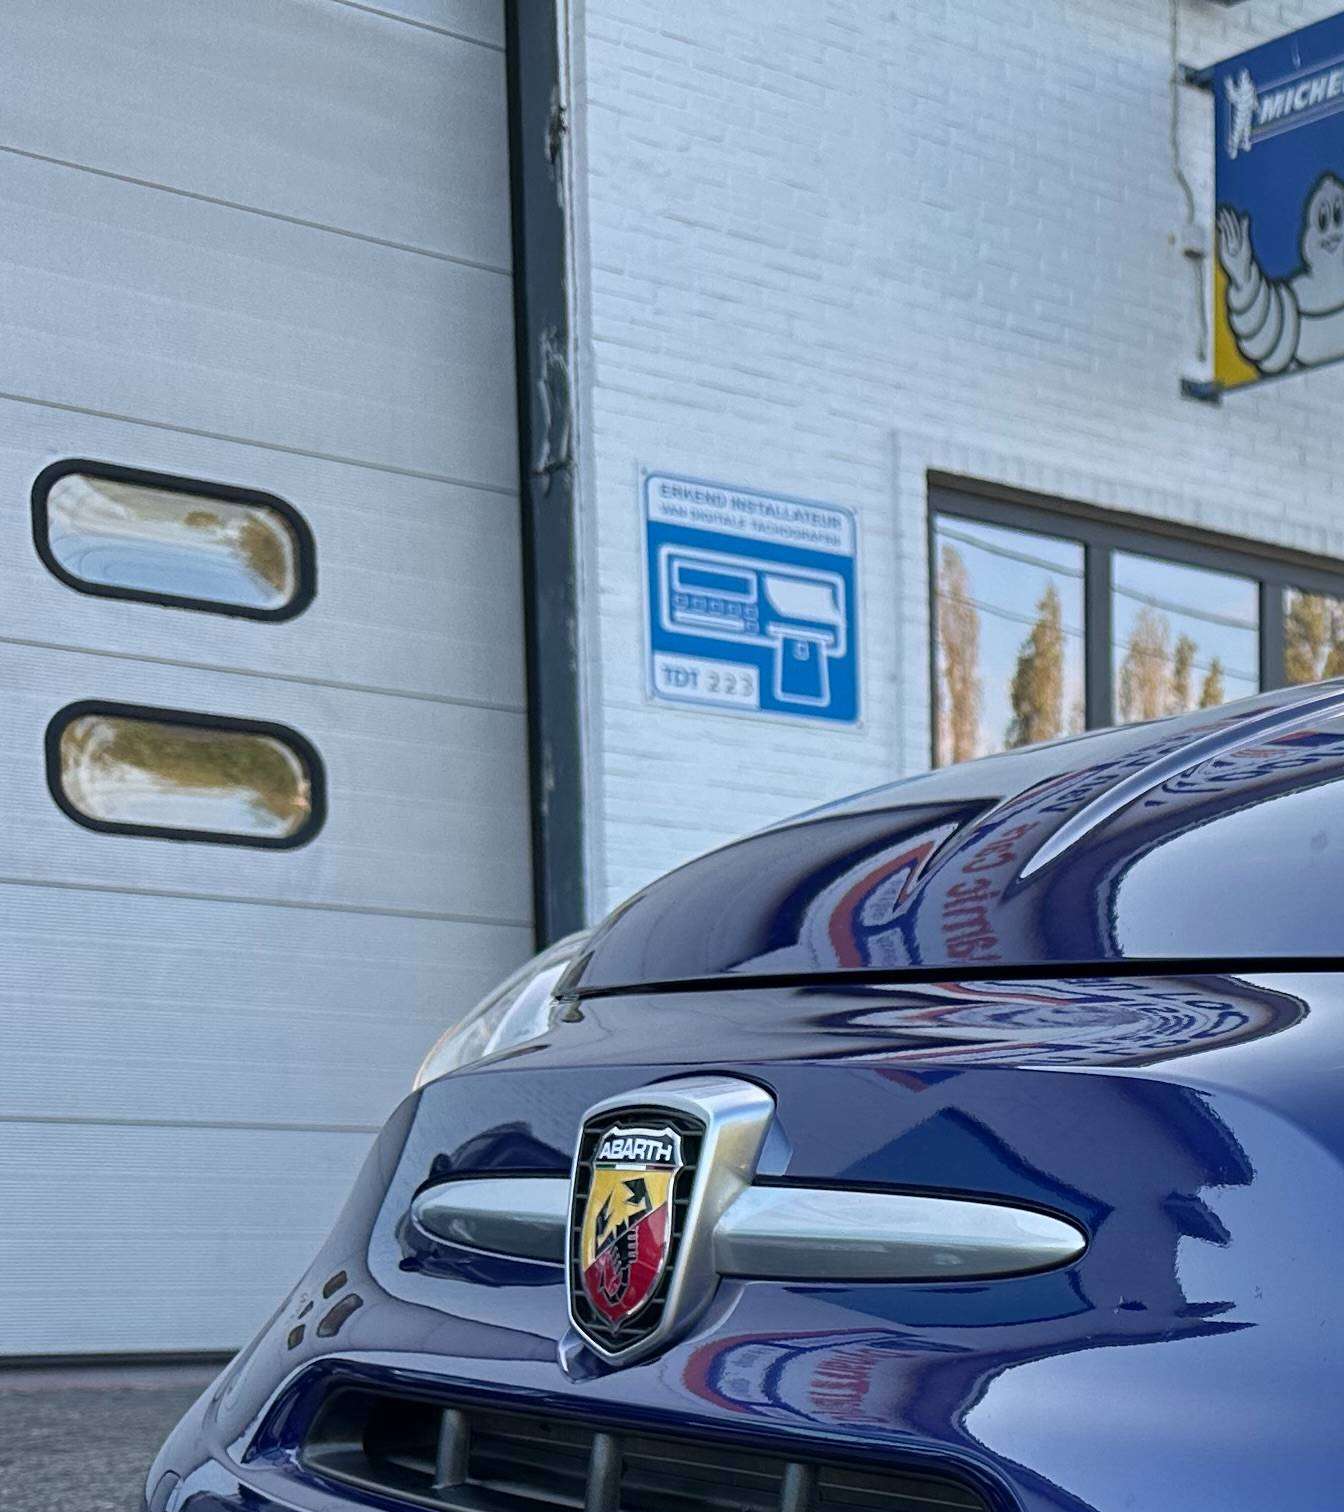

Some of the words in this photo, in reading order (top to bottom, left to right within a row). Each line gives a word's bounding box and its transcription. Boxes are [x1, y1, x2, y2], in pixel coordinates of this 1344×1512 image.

[660, 483, 727, 508] ERKEND
[731, 494, 842, 529] INSTALLATEUR
[661, 663, 699, 688] TDT
[706, 671, 754, 697] 223
[600, 1137, 673, 1161] ABARTH
